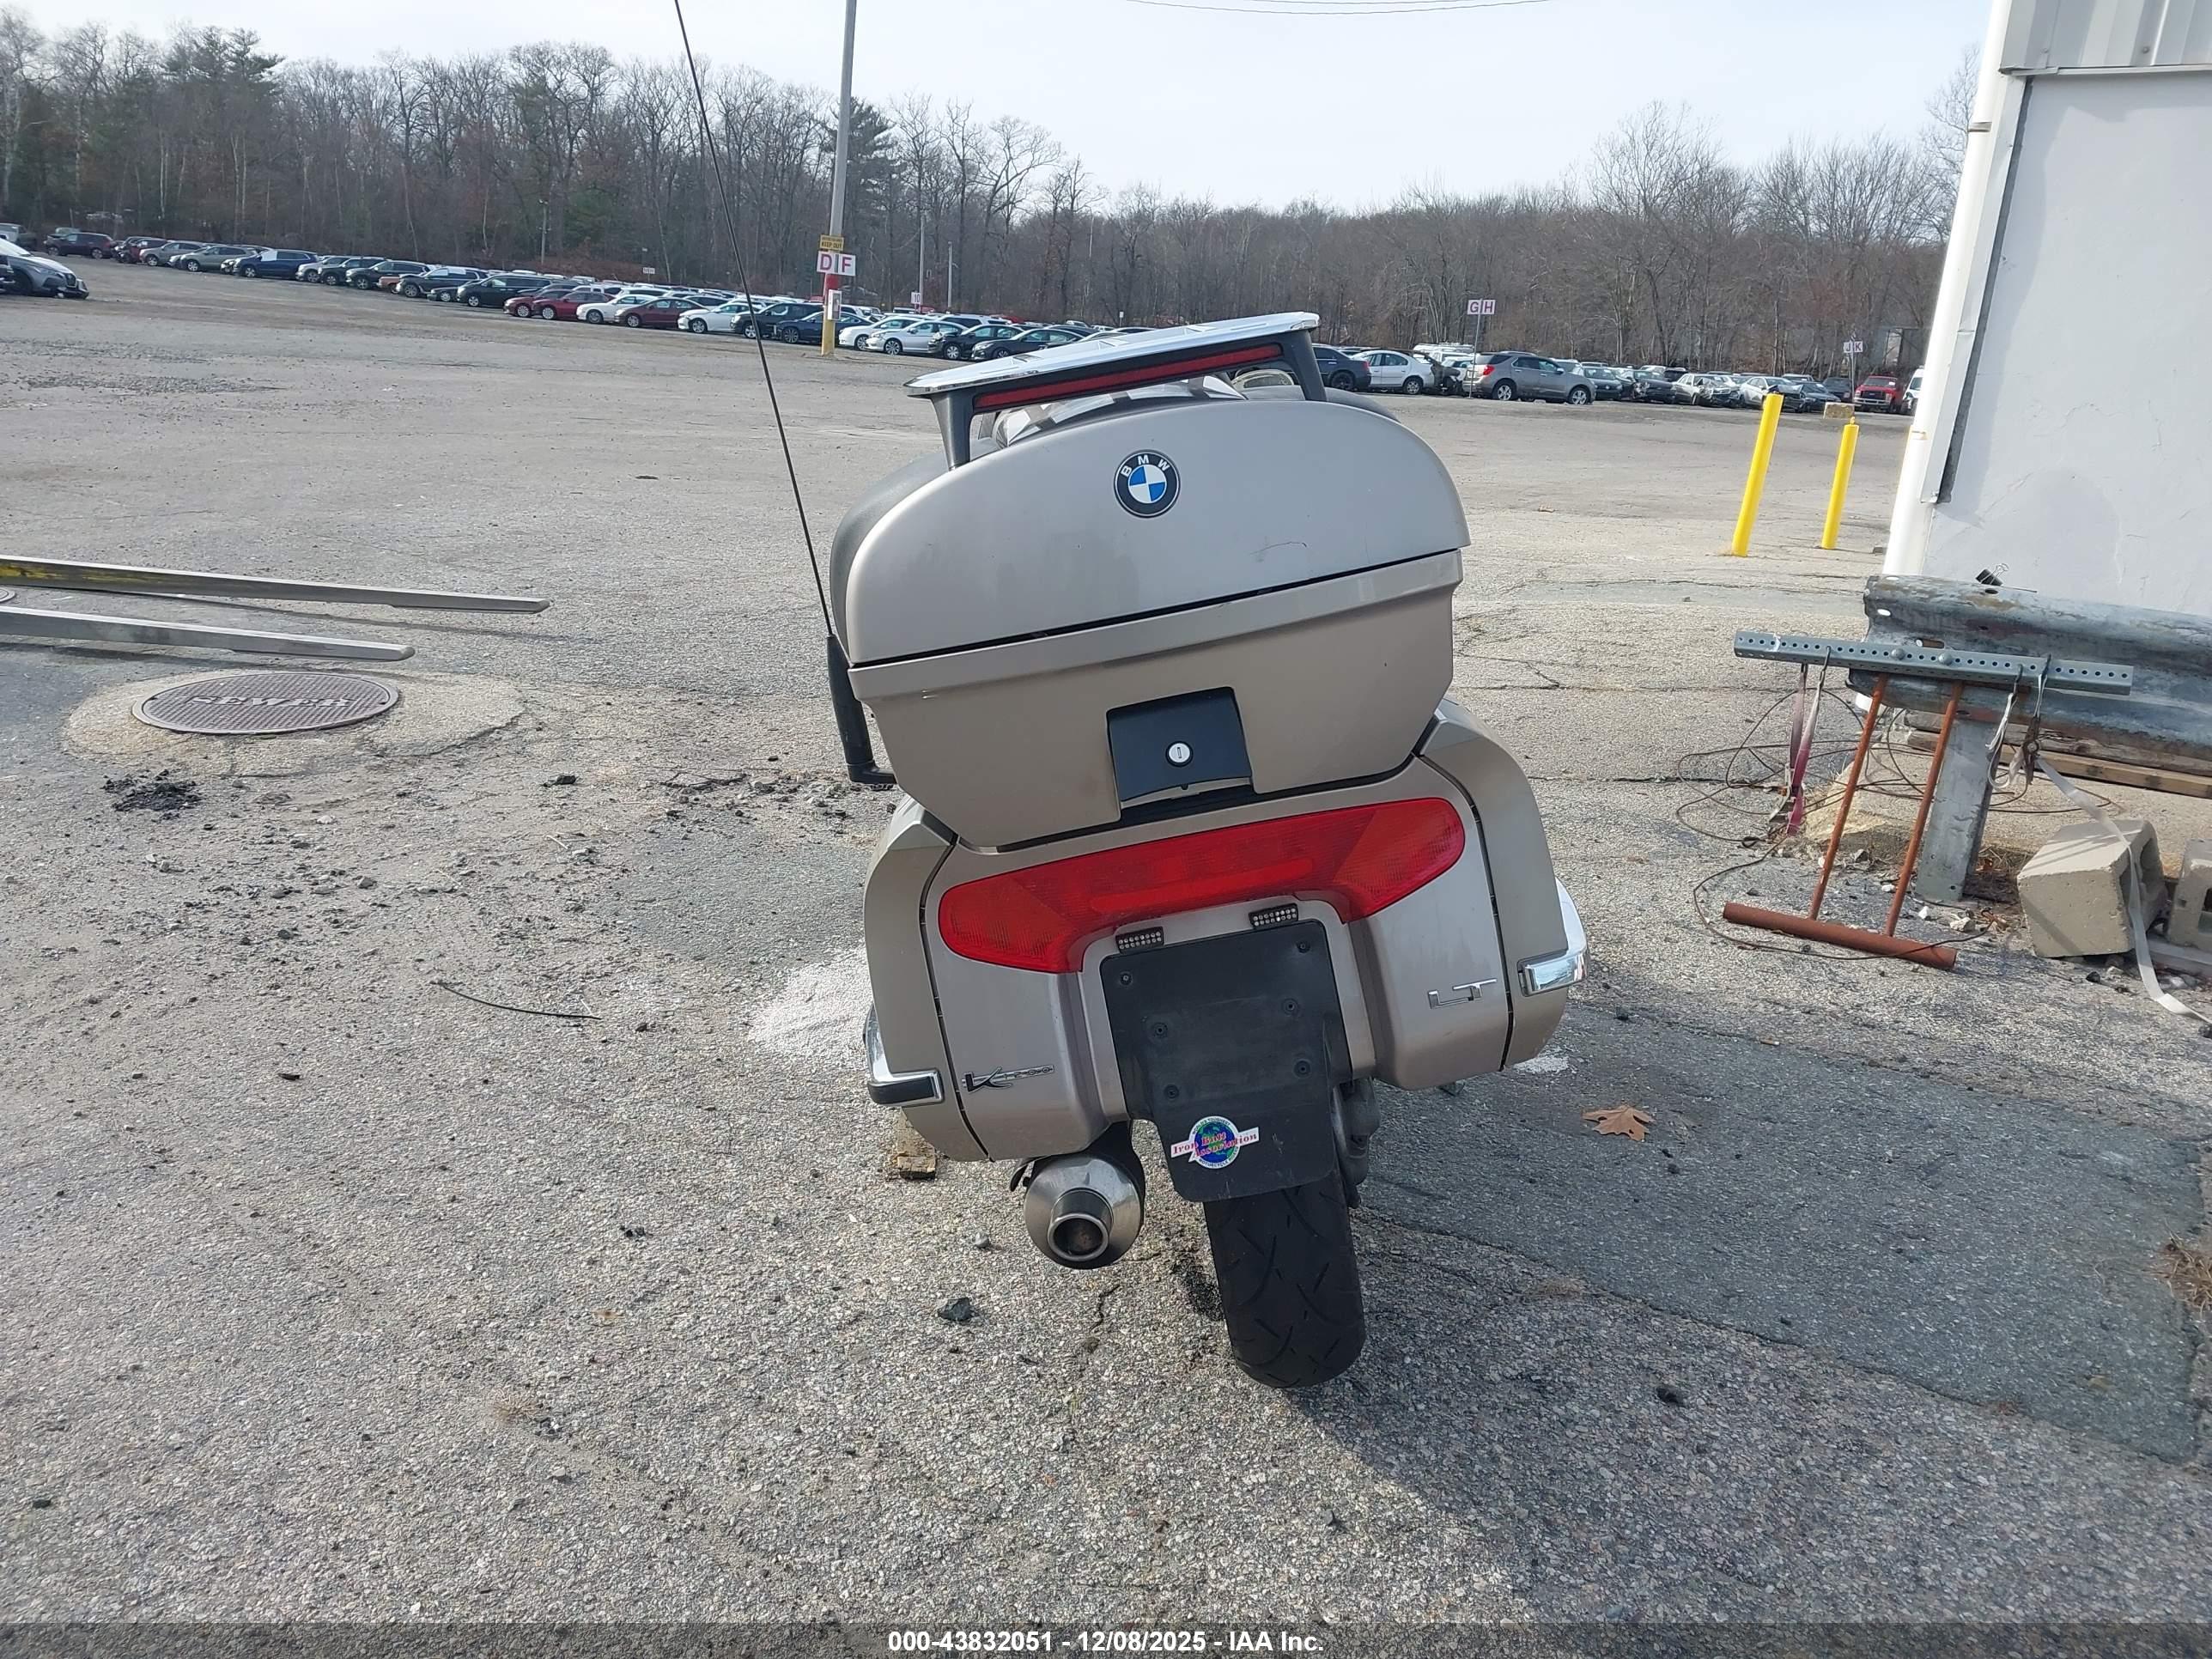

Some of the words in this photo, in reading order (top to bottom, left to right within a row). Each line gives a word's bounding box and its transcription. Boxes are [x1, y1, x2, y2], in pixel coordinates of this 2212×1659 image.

[1121, 454, 1170, 477] BMW
[186, 696, 355, 708] SEWER
[1428, 978, 1497, 1009] LT
[1173, 1140, 1199, 1154] Iron
